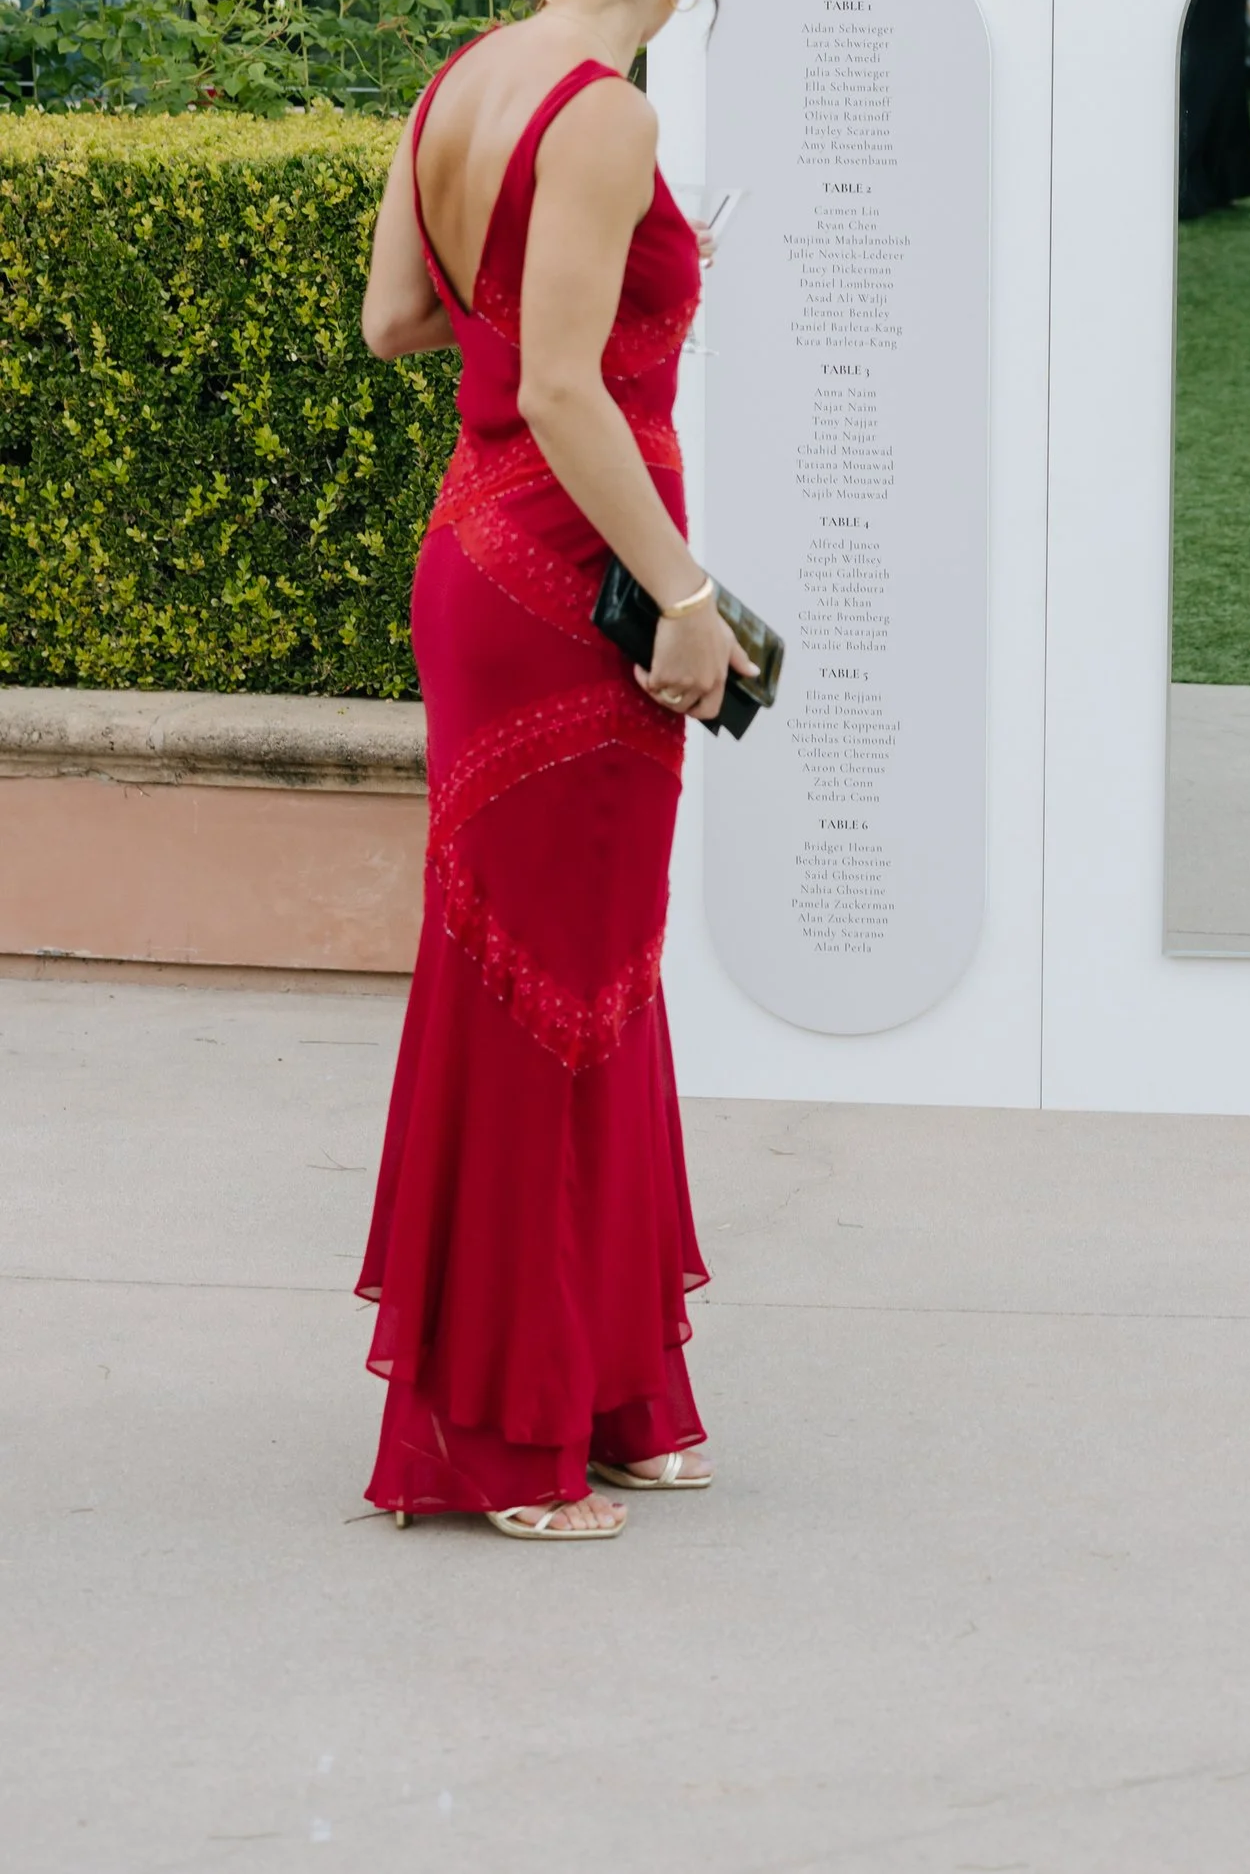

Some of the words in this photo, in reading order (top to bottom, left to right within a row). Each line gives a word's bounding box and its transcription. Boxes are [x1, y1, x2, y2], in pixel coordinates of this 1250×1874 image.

[824, 1, 864, 11] TABLE
[801, 23, 835, 33] Aidan
[806, 37, 830, 47] Lara
[804, 66, 831, 78] Julia
[803, 95, 840, 107] Joshua
[800, 139, 826, 152] Amy
[830, 139, 893, 150] Rosenbaum
[796, 154, 831, 164] Aaron
[834, 154, 898, 166] Rosenbaum
[823, 184, 863, 194] TABLE
[813, 205, 857, 216] Carmen
[861, 206, 880, 216] Lin
[817, 219, 845, 232] Ryan
[848, 220, 877, 230] Chen
[788, 247, 815, 260] Julie
[802, 263, 828, 276] Lucy
[832, 263, 892, 274] Dickerman
[799, 277, 835, 287] Daniel
[821, 365, 861, 375] TABLE
[811, 415, 840, 428] Tony
[795, 472, 839, 483] Michele
[820, 518, 860, 528] TABLE
[806, 553, 838, 566] Steph
[804, 582, 828, 592] Sara
[797, 611, 833, 621] Claire
[801, 639, 842, 649] Natalie
[819, 668, 859, 678] TABLE
[805, 704, 830, 714] Ford
[834, 704, 883, 715] Donovan
[786, 718, 839, 729] Christine
[791, 732, 839, 743] Nicholas
[797, 747, 840, 757] Colleen
[813, 776, 840, 786] Zach
[843, 777, 874, 787] Conn
[819, 820, 858, 830] TABLE
[791, 897, 830, 908] Pamela
[834, 898, 897, 910] Zuckerman
[797, 913, 823, 923] Alan
[827, 913, 889, 924] Zuckerman
[802, 927, 837, 940] Mindy
[813, 940, 840, 950] Alan
[844, 941, 872, 951] Perla
